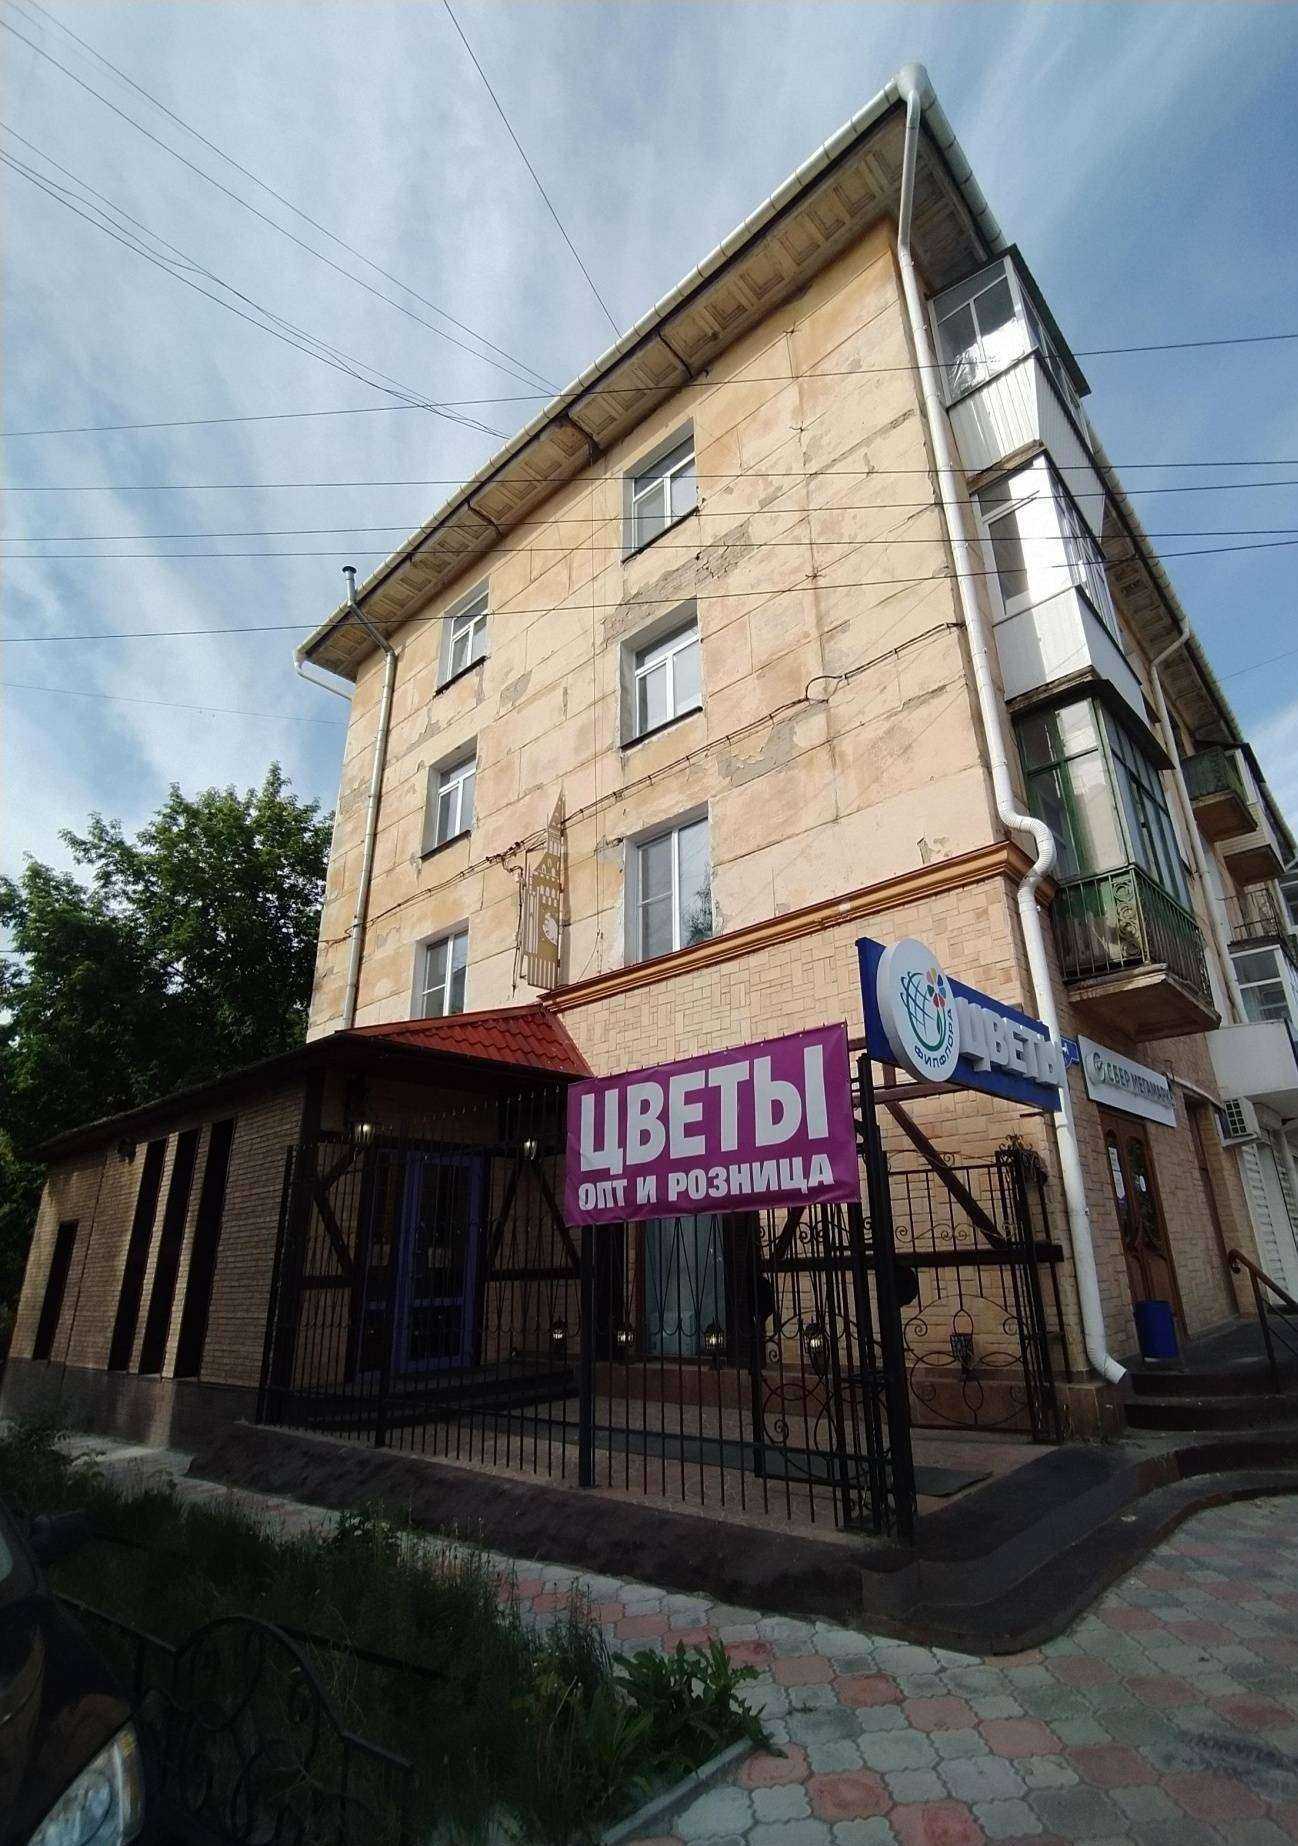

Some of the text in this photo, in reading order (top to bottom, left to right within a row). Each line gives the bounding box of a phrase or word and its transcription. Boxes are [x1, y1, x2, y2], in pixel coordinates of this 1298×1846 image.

[956, 995, 1065, 1088] ЦВЕТЫ
[580, 1044, 829, 1175] ЦВЕТЫ
[578, 1153, 835, 1211] ОПТ И РОЗНИЦА
